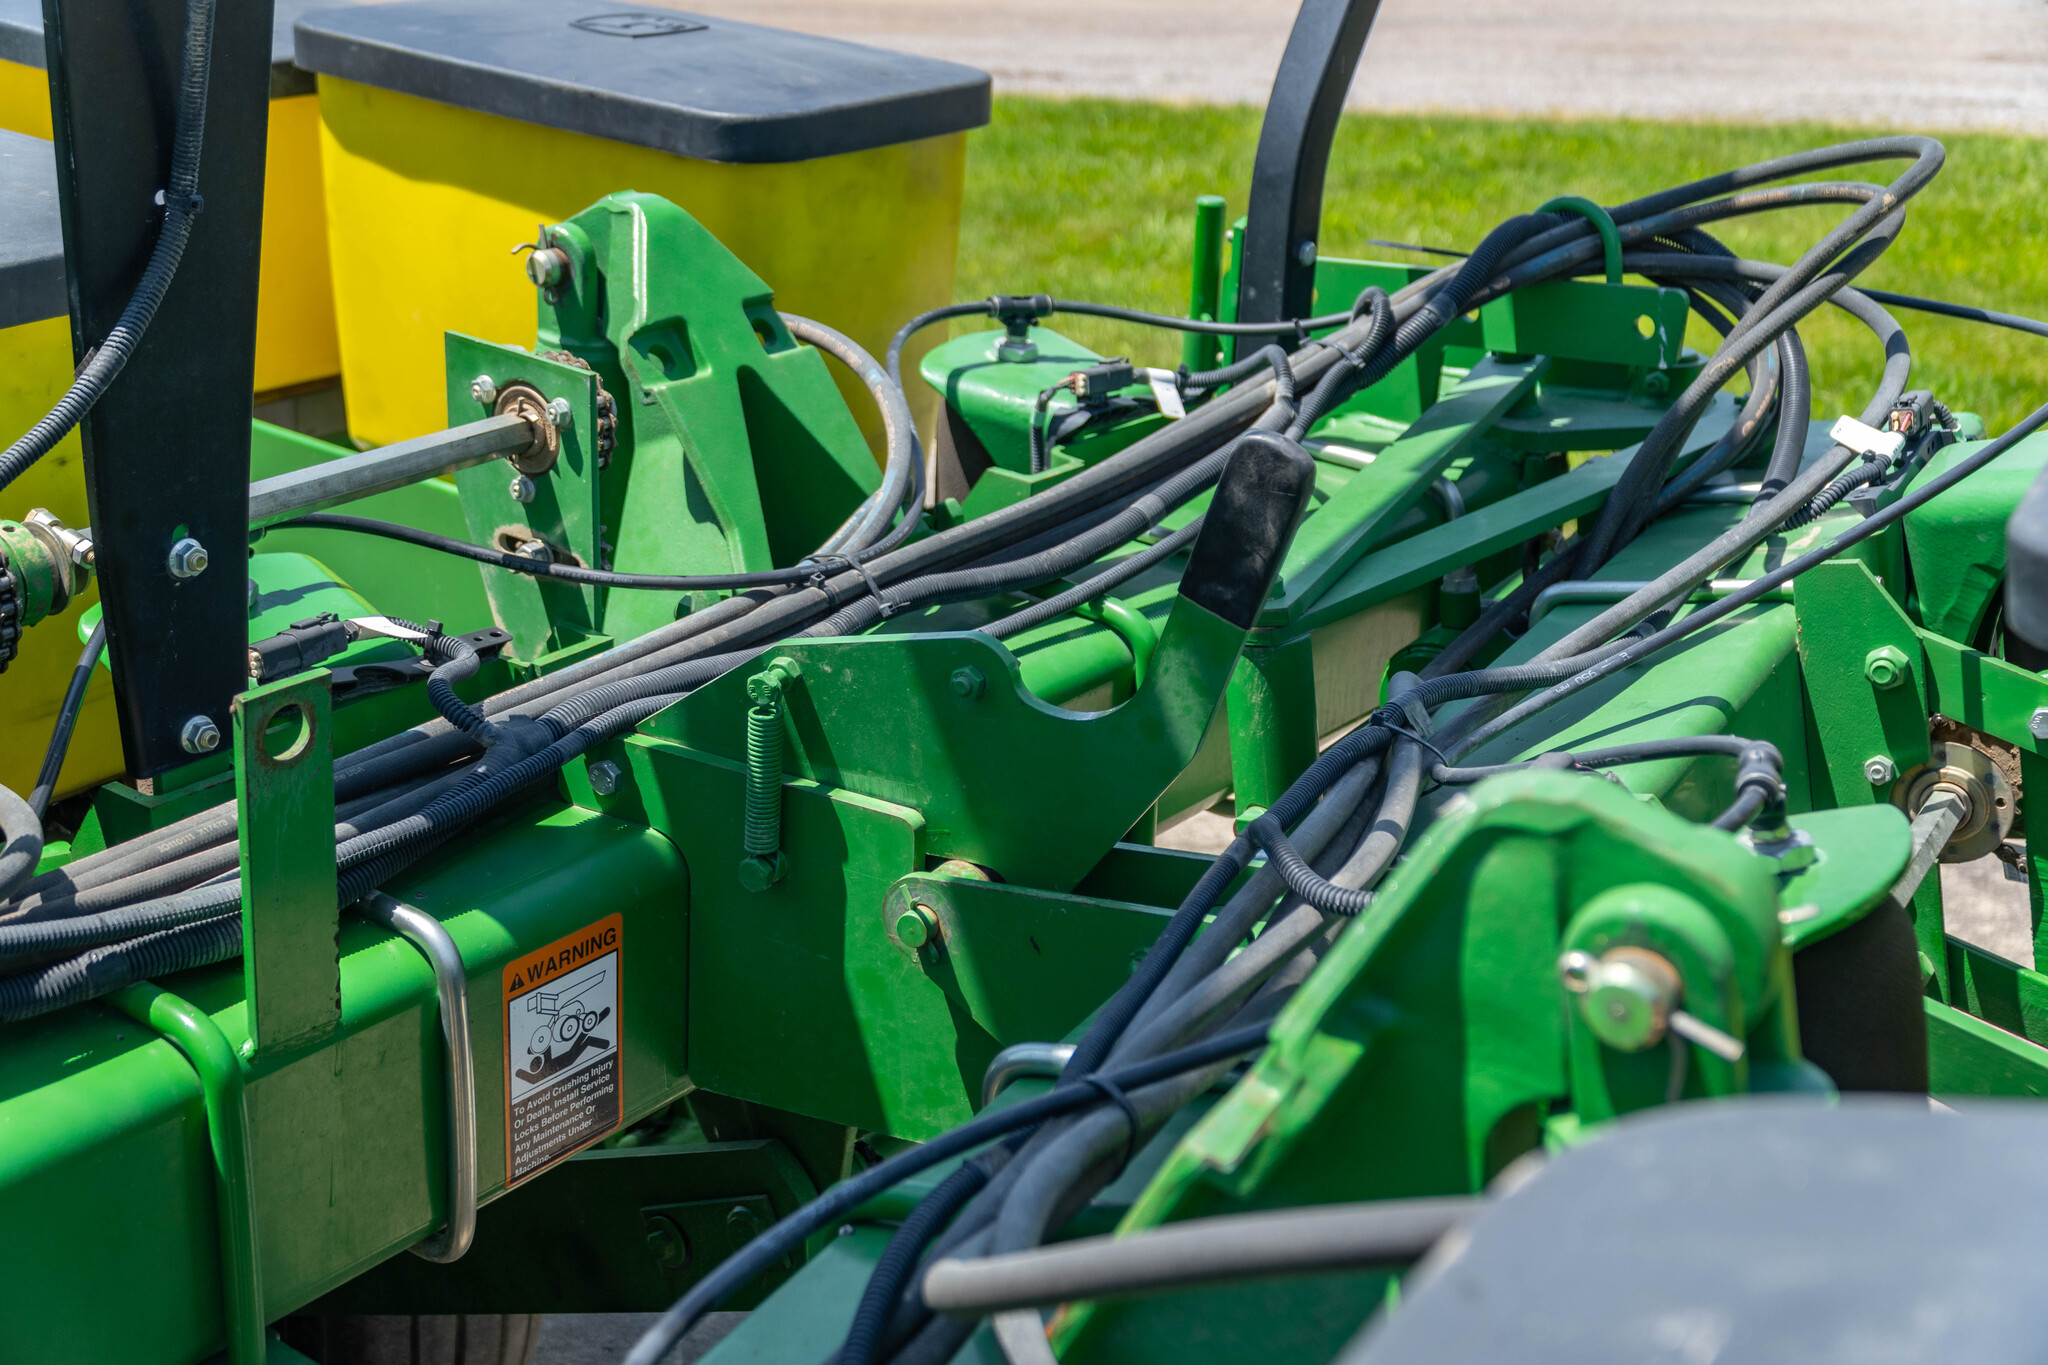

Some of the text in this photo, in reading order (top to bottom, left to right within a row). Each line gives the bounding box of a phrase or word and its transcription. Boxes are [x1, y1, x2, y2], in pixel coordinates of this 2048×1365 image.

[527, 927, 617, 982] WARNING
[514, 1060, 613, 1117] To Avoid Crushing Injury
[514, 1073, 610, 1129] Or Death, Install Service
[514, 1083, 614, 1141] Locks Before Performing
[515, 1104, 596, 1153] Any Maintenance Or
[515, 1118, 593, 1166] Adjustments Under
